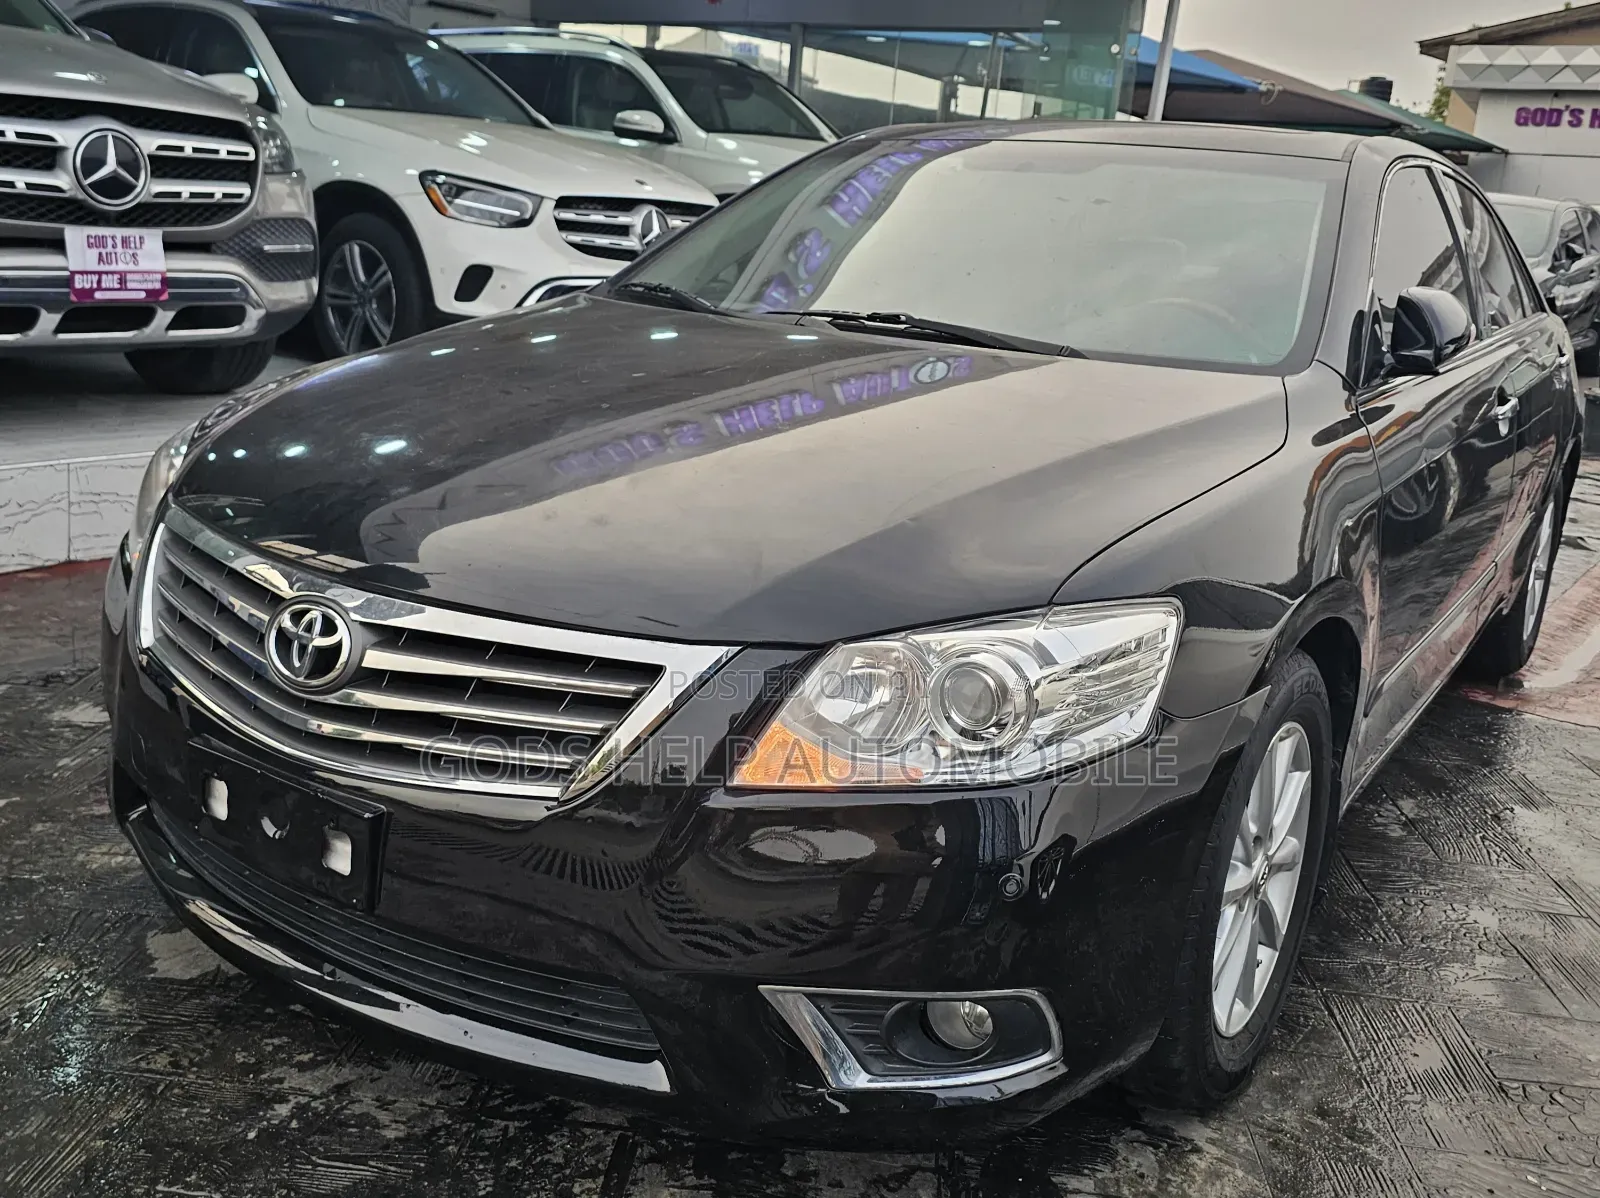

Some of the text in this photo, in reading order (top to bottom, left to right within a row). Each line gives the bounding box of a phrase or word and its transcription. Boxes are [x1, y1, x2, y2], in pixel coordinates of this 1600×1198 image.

[1515, 104, 1585, 128] GOD'S
[86, 234, 145, 250] GOD'S HELP
[74, 273, 99, 289] BUY
[101, 273, 121, 289] ME
